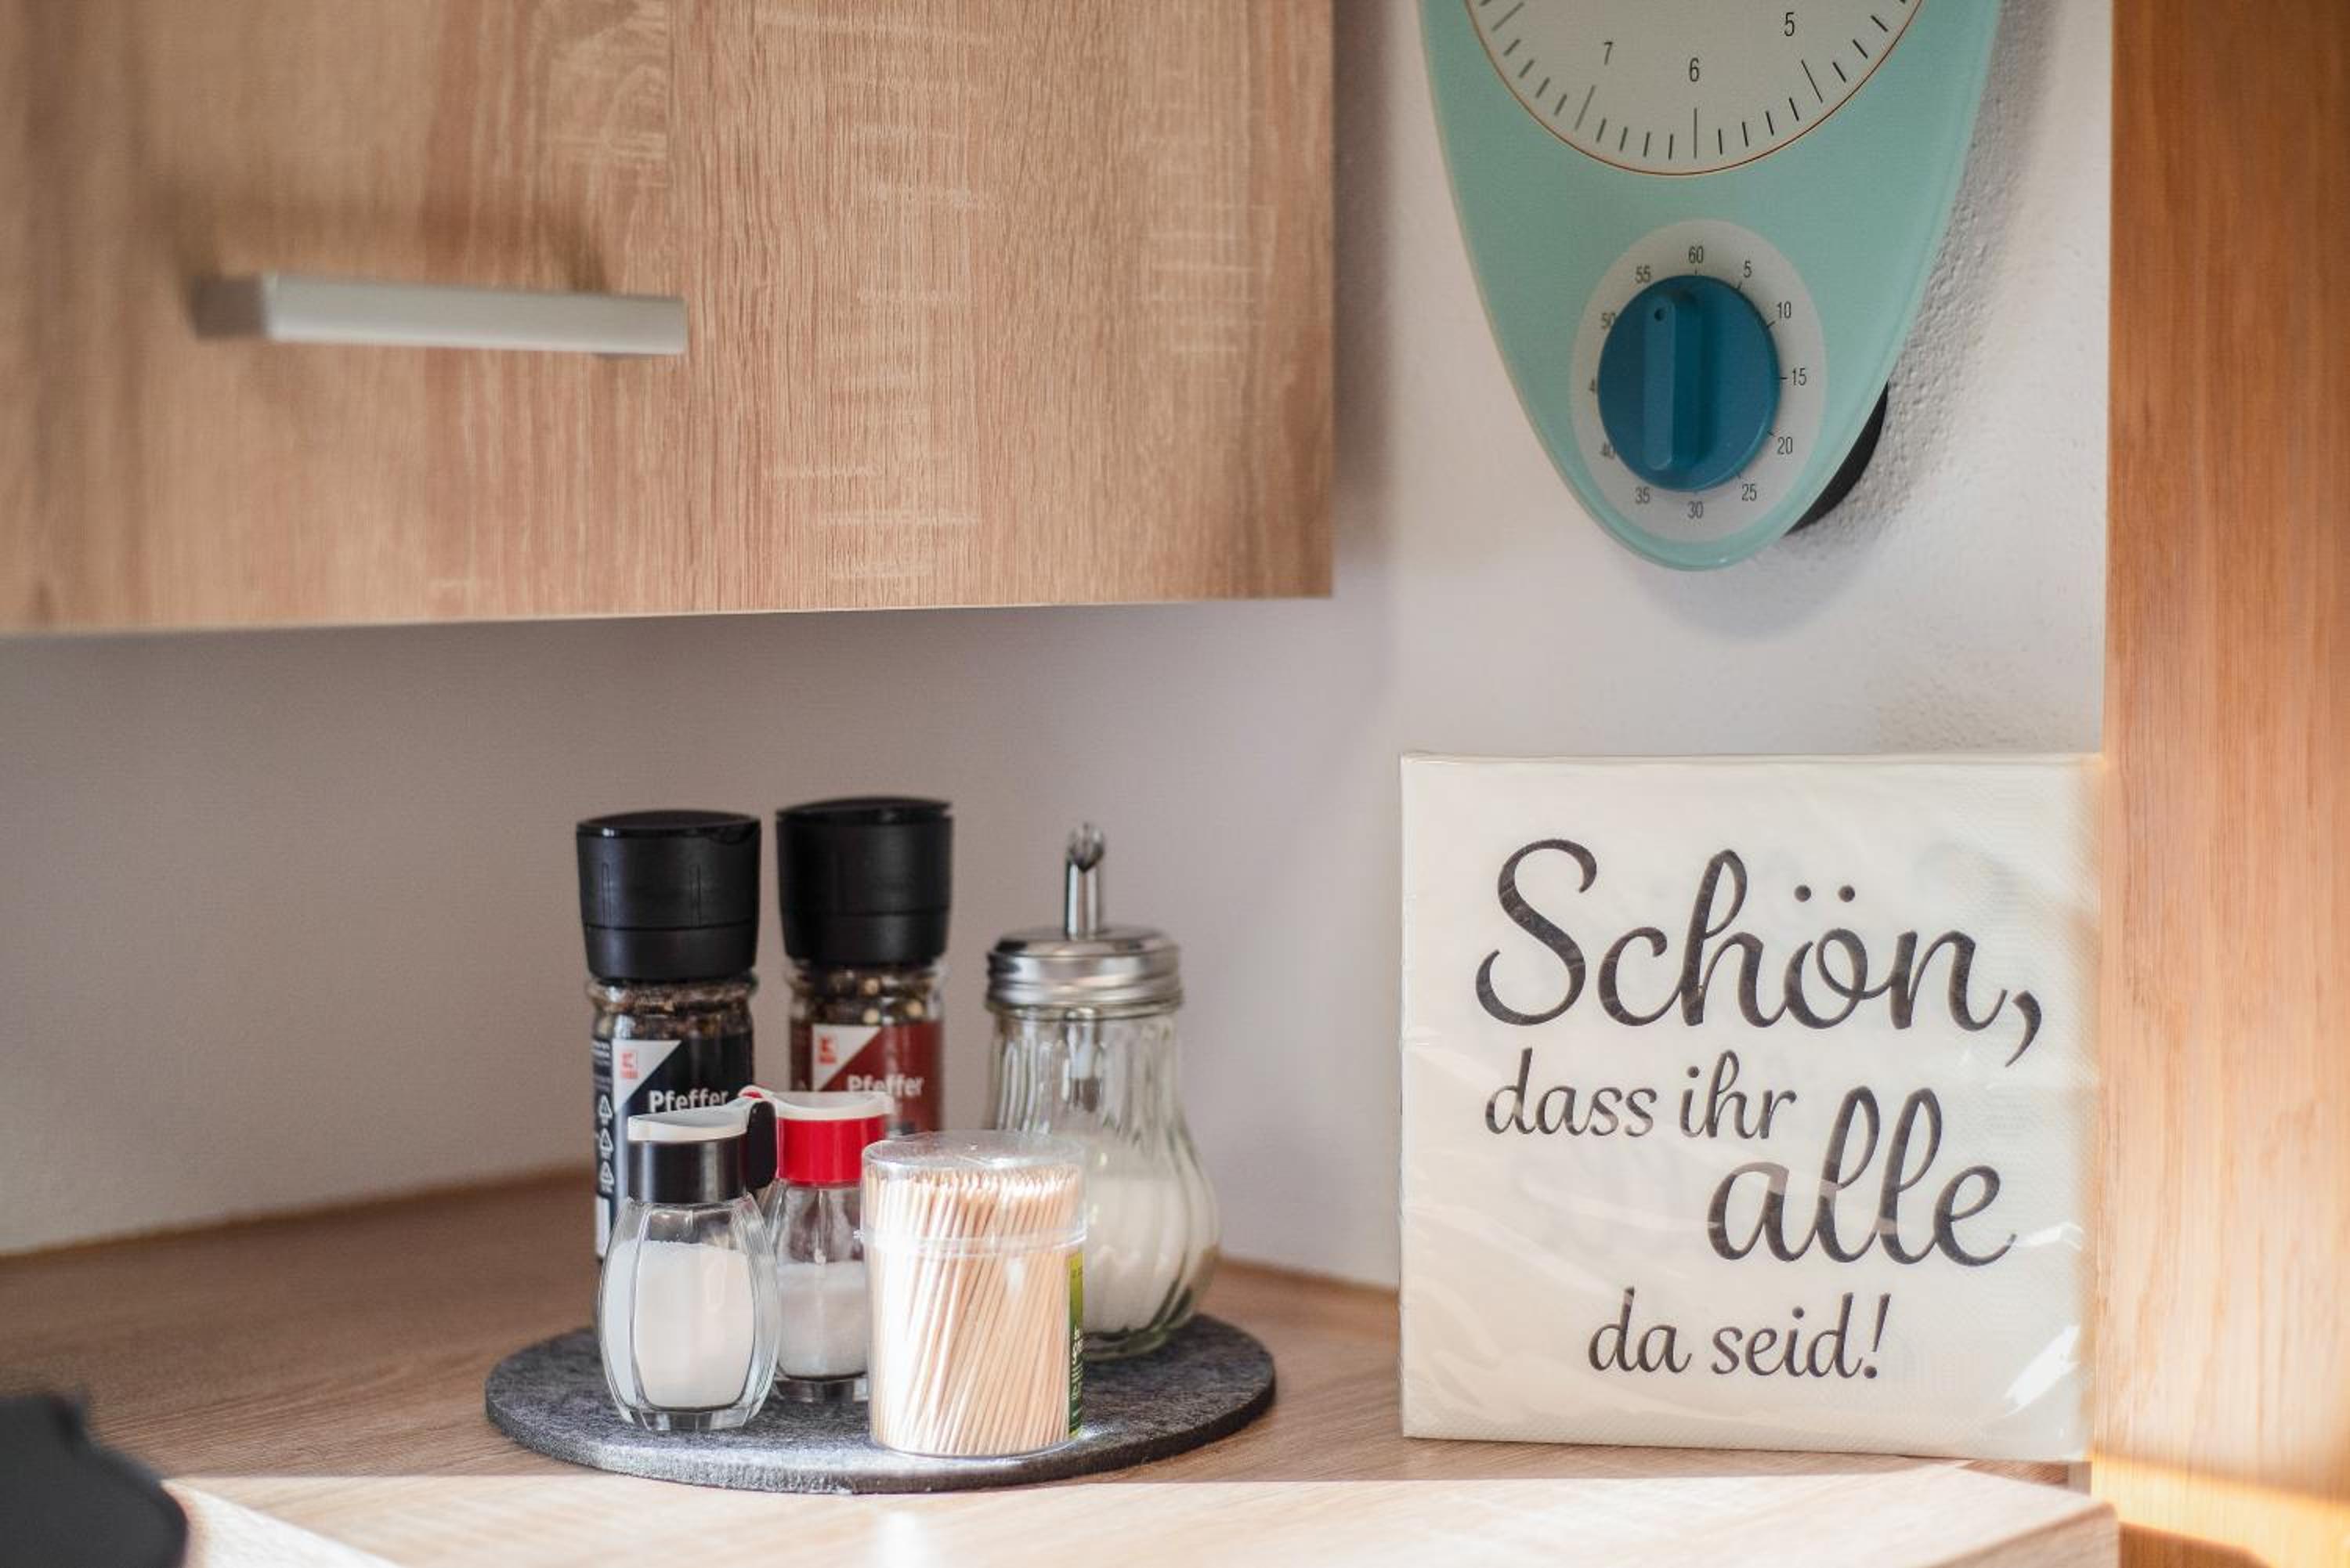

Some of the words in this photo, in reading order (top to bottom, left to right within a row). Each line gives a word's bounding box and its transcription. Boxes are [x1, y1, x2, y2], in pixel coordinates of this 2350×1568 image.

[1784, 11, 1795, 37] 5
[1603, 41, 1614, 66] 7
[1688, 57, 1701, 82] 6
[1688, 246, 1705, 264] 60
[1635, 266, 1651, 284] 55
[1743, 260, 1752, 278] 5
[1777, 302, 1791, 320] 10
[1791, 367, 1807, 386] 15
[1777, 436, 1793, 455] 20
[1634, 486, 1650, 504] 35
[1741, 483, 1757, 502] 25
[1687, 500, 1704, 519] 30
[1475, 839, 2043, 1068] Schön,
[847, 1074, 924, 1098] Pfeffer
[1485, 1048, 1658, 1137] dass
[1680, 1050, 1797, 1139] ihr
[649, 1088, 729, 1113] Pfeffer
[1707, 1086, 2016, 1266] alle
[1588, 1287, 1692, 1373] da
[1712, 1292, 1892, 1379] seid!
